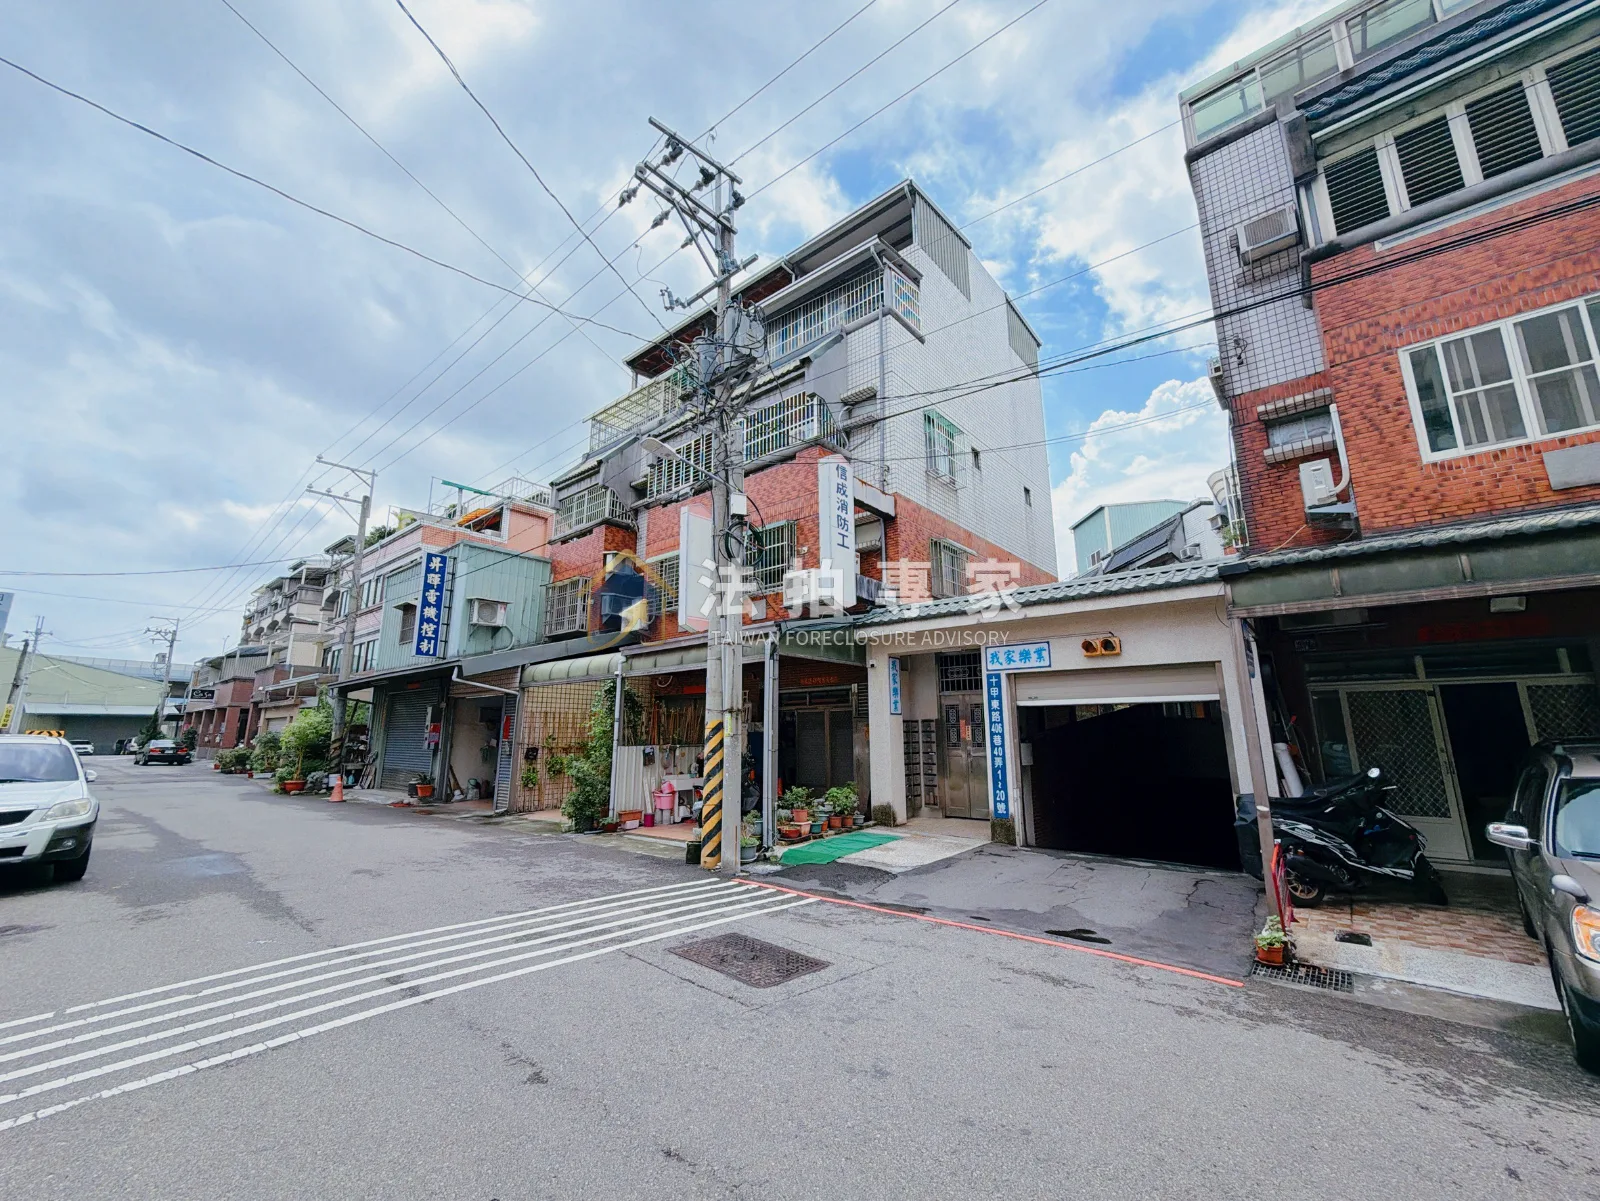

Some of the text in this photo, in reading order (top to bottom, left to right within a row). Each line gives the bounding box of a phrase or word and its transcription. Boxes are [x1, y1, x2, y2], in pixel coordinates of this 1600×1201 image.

[835, 463, 850, 550] 信成消防工
[989, 646, 1047, 667] 我家樂業
